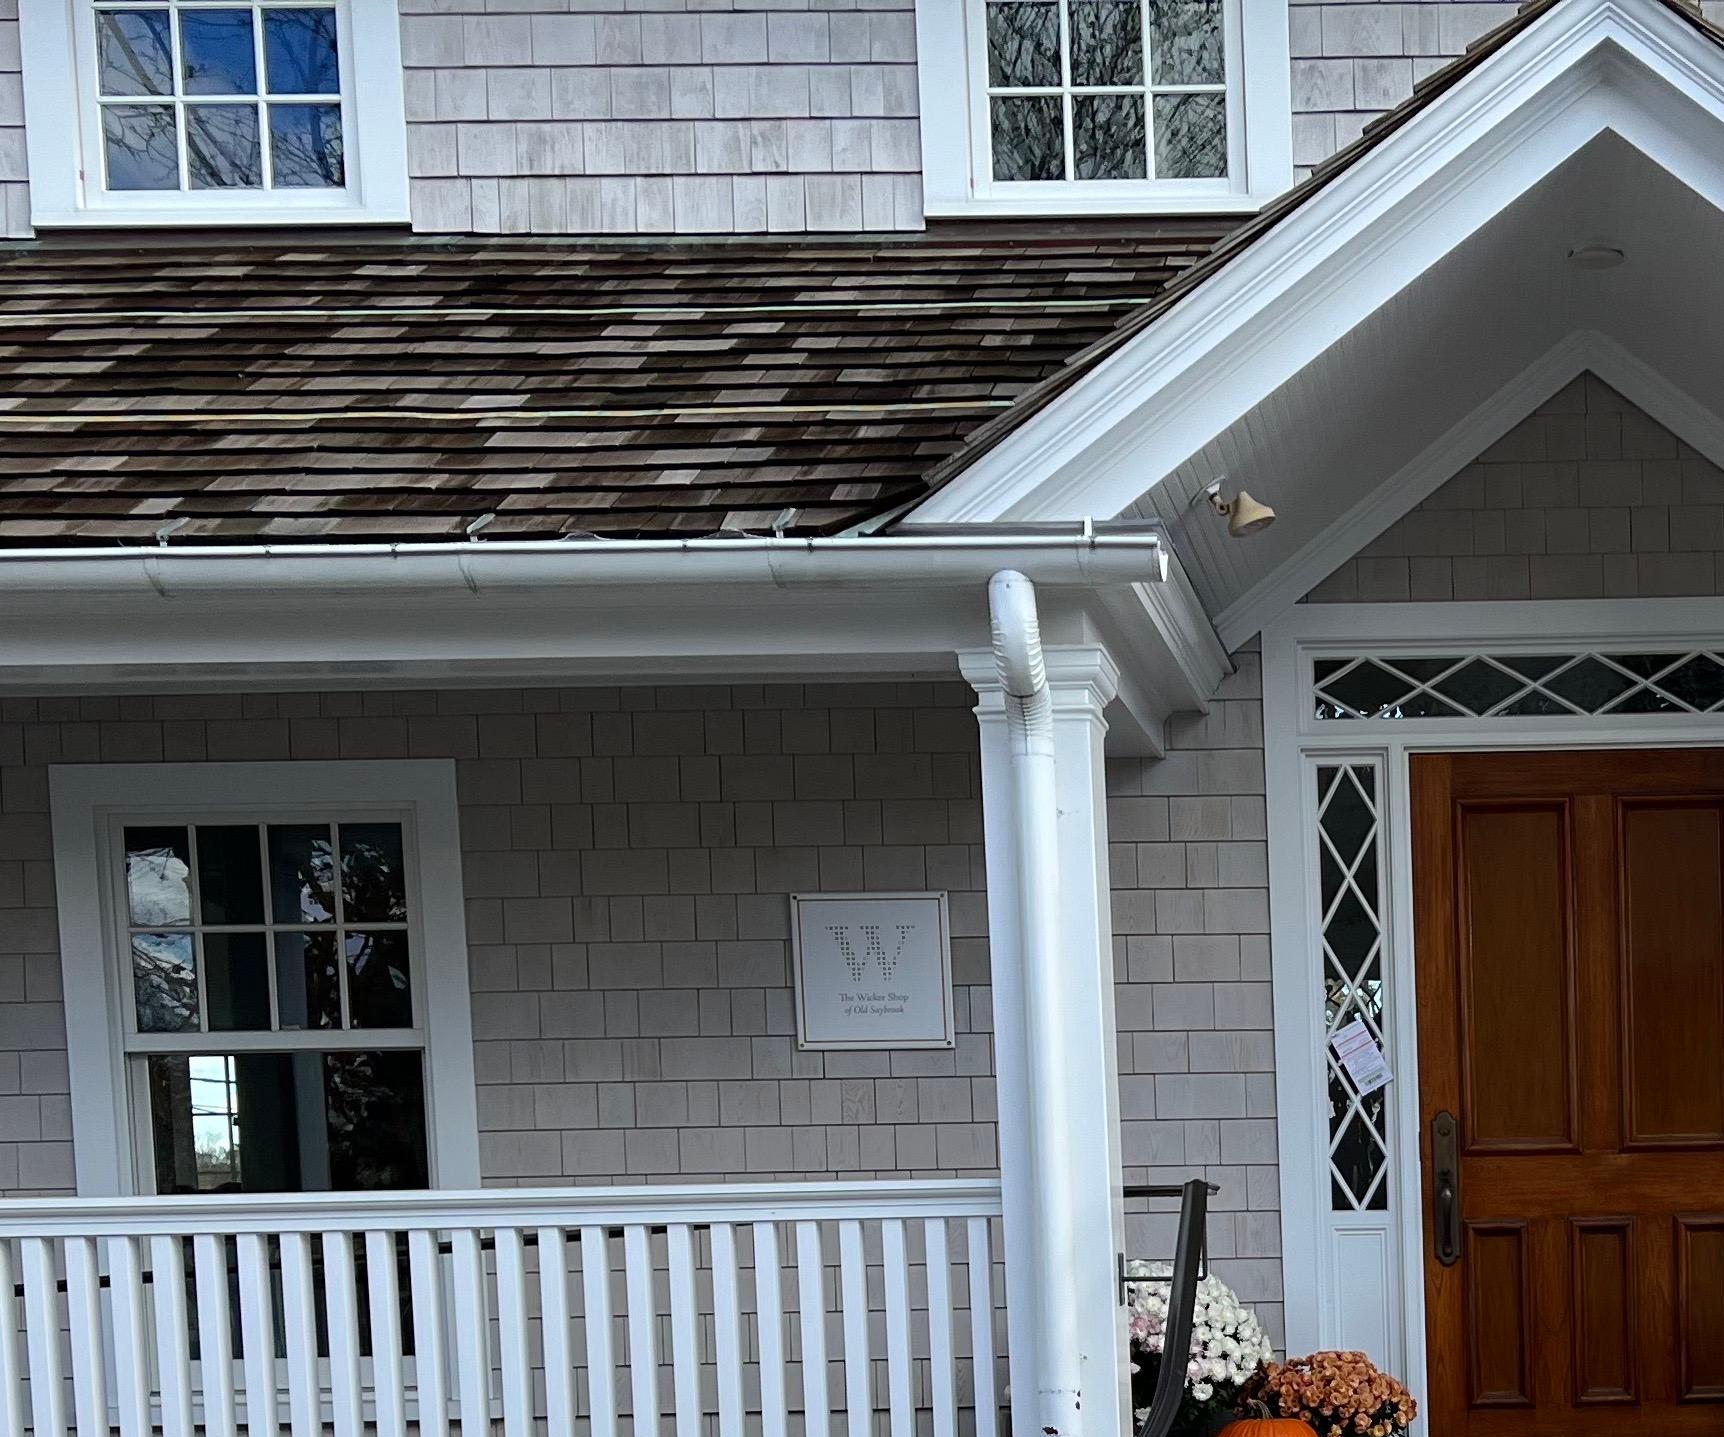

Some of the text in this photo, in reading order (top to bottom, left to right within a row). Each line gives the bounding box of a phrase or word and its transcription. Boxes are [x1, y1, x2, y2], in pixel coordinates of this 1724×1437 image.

[839, 993, 909, 1003] The Wicker Shop
[844, 1004, 904, 1016] of Old Saybrook
